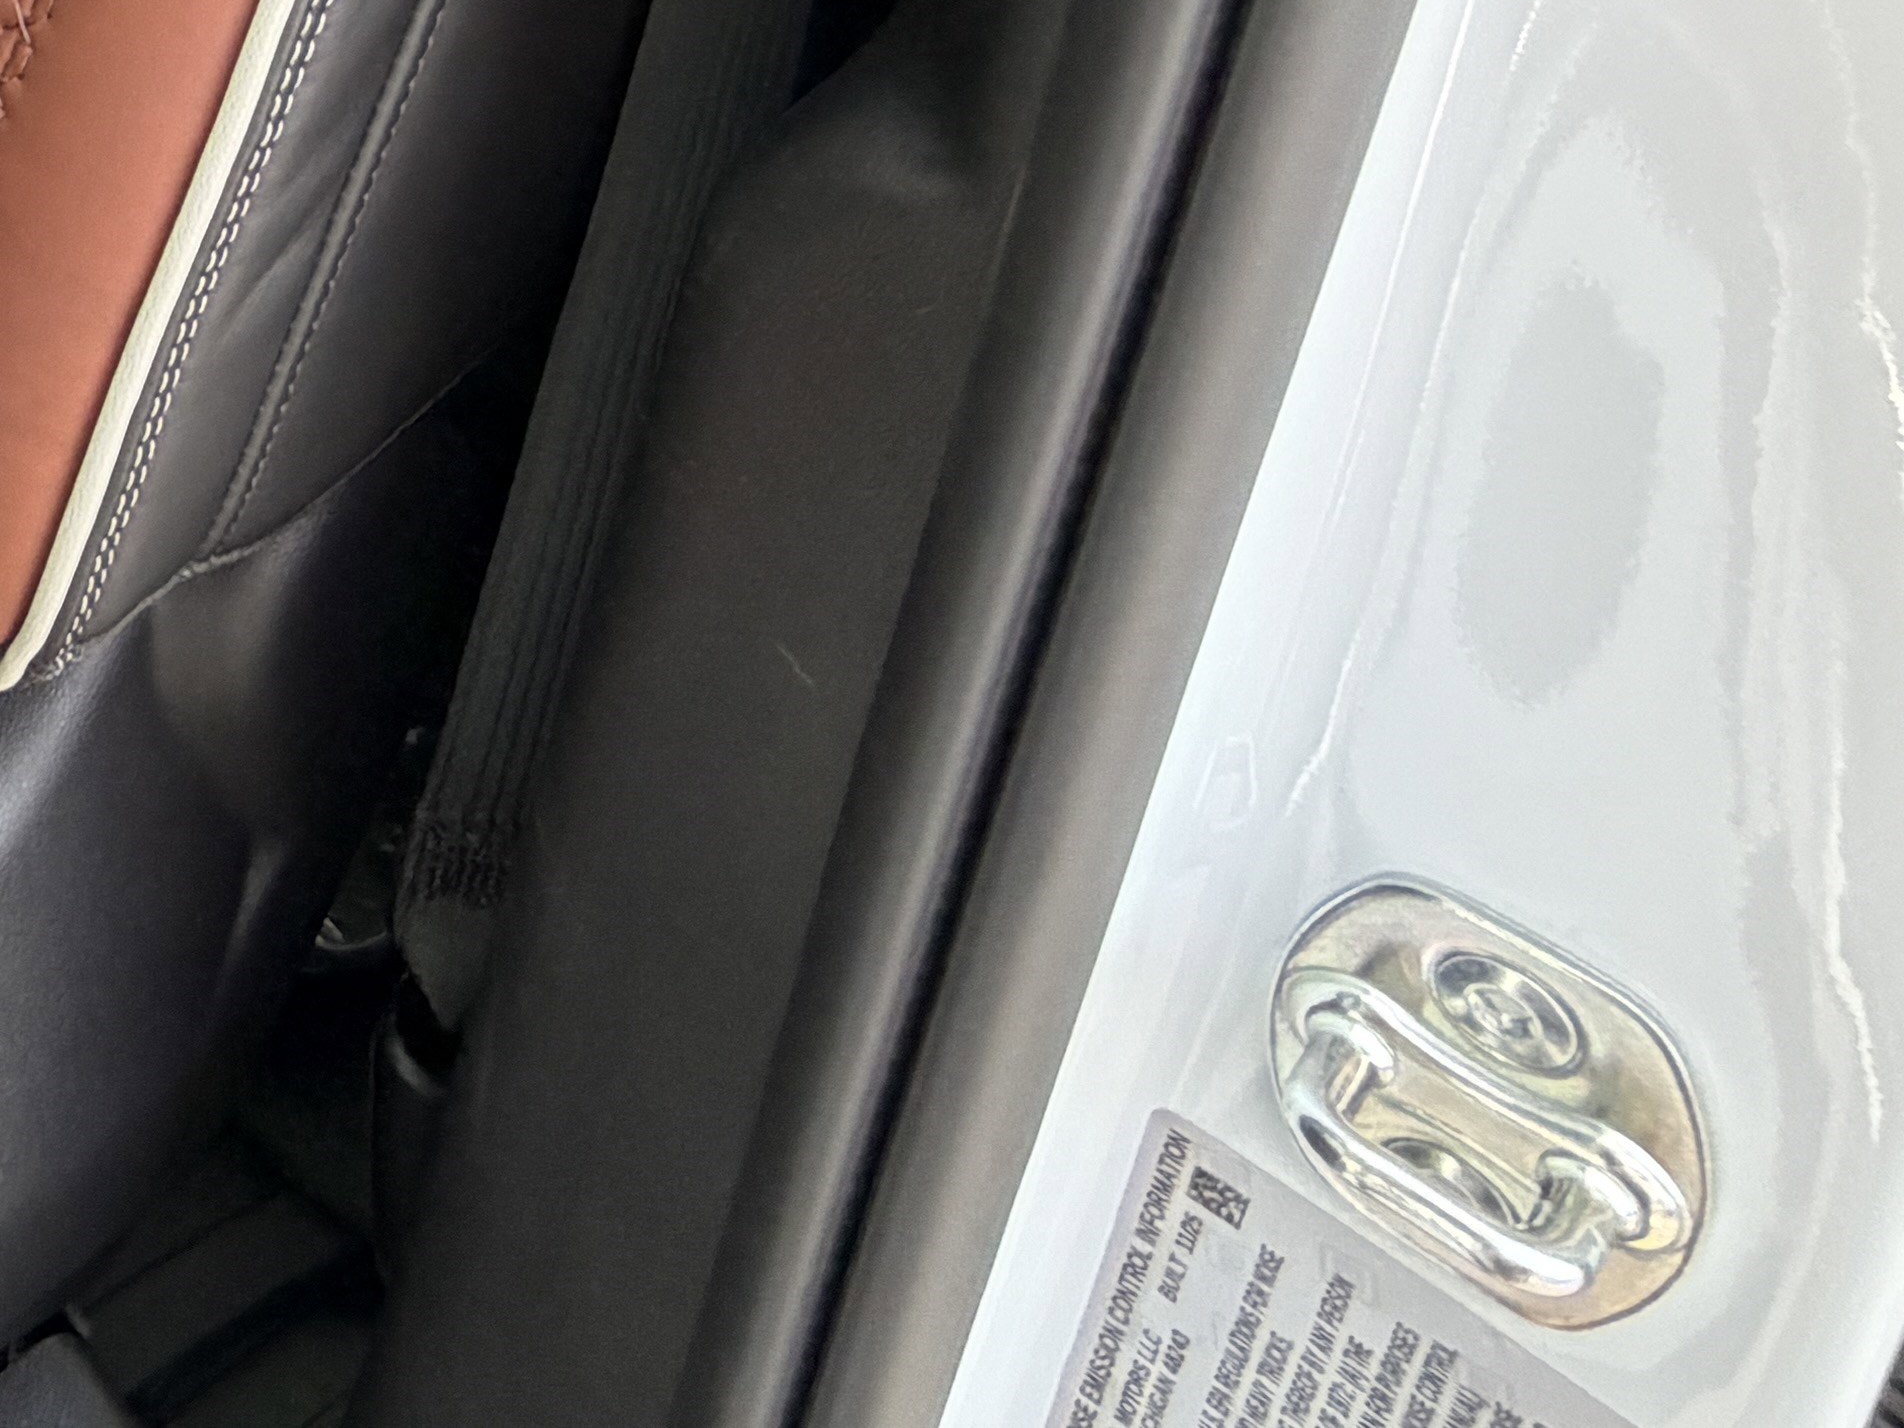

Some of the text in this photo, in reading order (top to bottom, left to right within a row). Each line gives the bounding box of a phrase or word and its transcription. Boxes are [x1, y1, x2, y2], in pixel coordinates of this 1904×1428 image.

[1080, 1320, 1126, 1406] EMISSION
[1108, 1244, 1153, 1326] CONTROL
[1135, 1128, 1191, 1247] INFORMATION
[1157, 1210, 1204, 1304] BUILT 11/25
[1316, 1272, 1356, 1332] PERSON
[1113, 1328, 1163, 1427] MOTORS LLC
[1213, 1305, 1262, 1390] REGULATIONS
